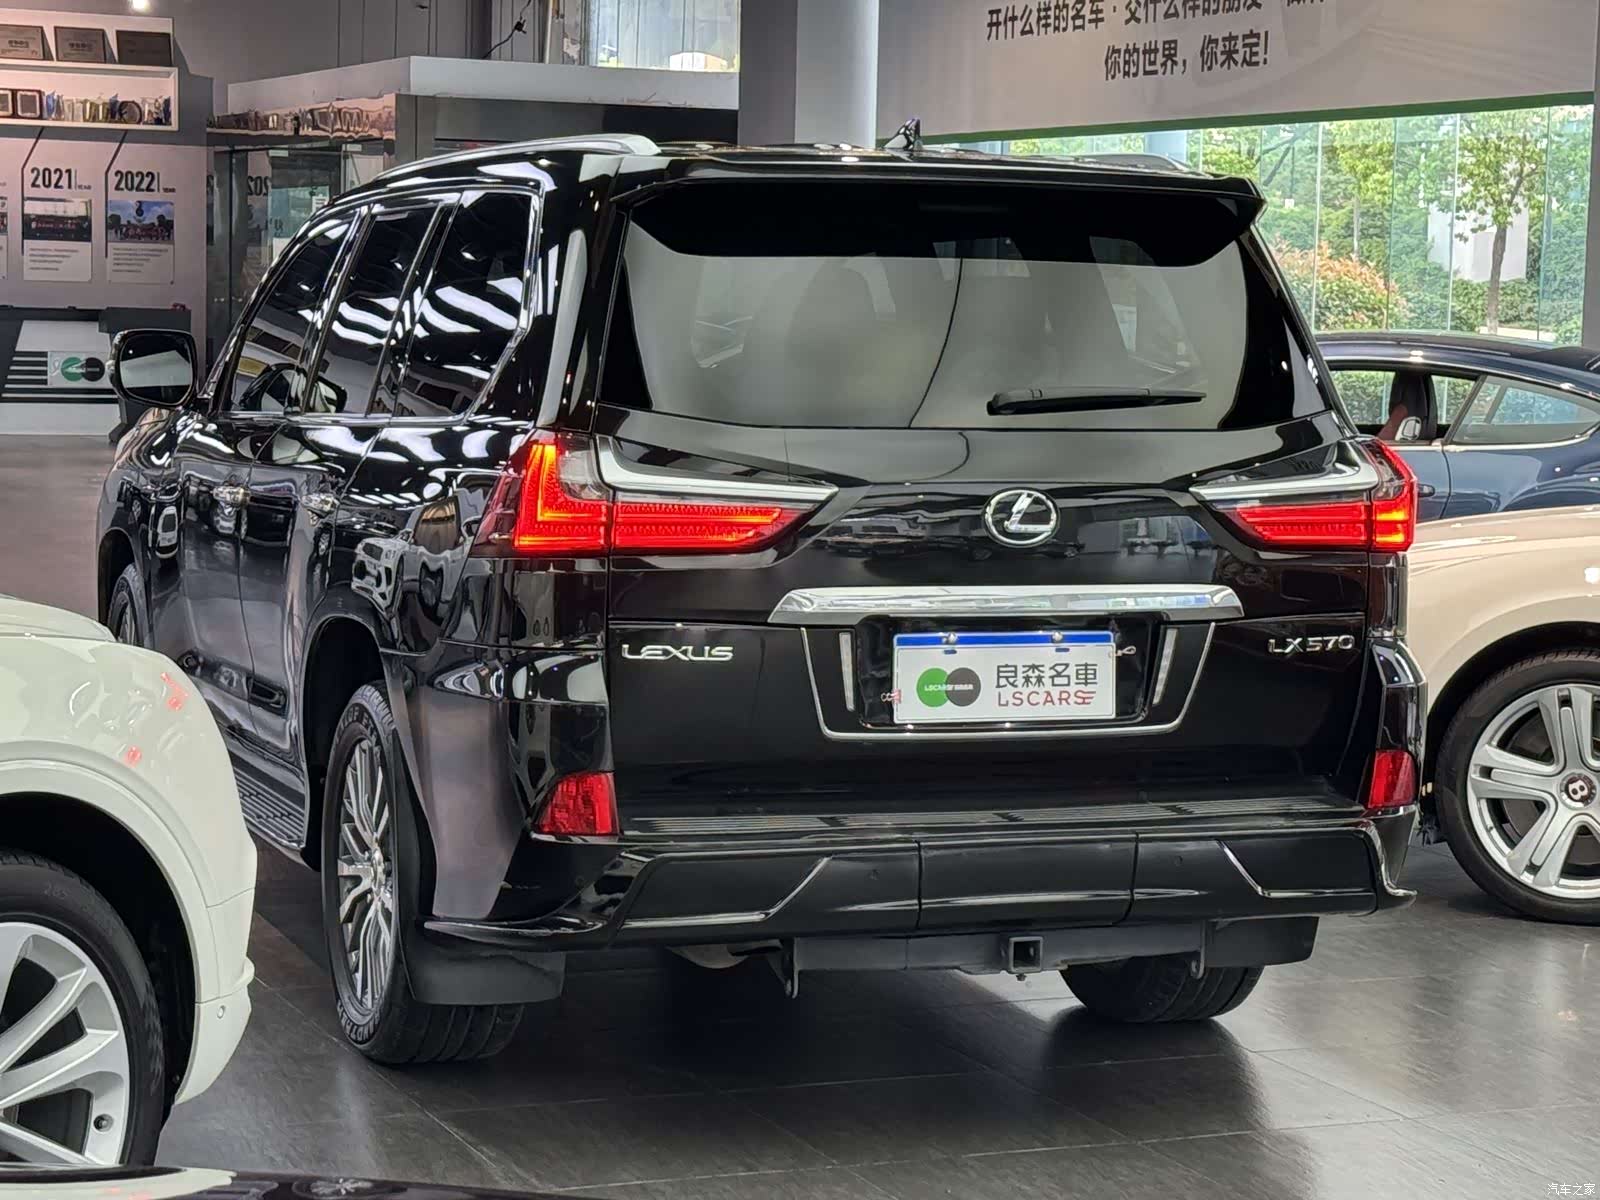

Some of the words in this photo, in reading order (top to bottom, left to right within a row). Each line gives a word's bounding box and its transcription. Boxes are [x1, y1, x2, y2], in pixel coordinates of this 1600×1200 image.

[30, 167, 73, 189] 2021
[114, 170, 156, 192] 2022
[622, 644, 733, 661] LEXUS
[995, 661, 1098, 688] 良森名車
